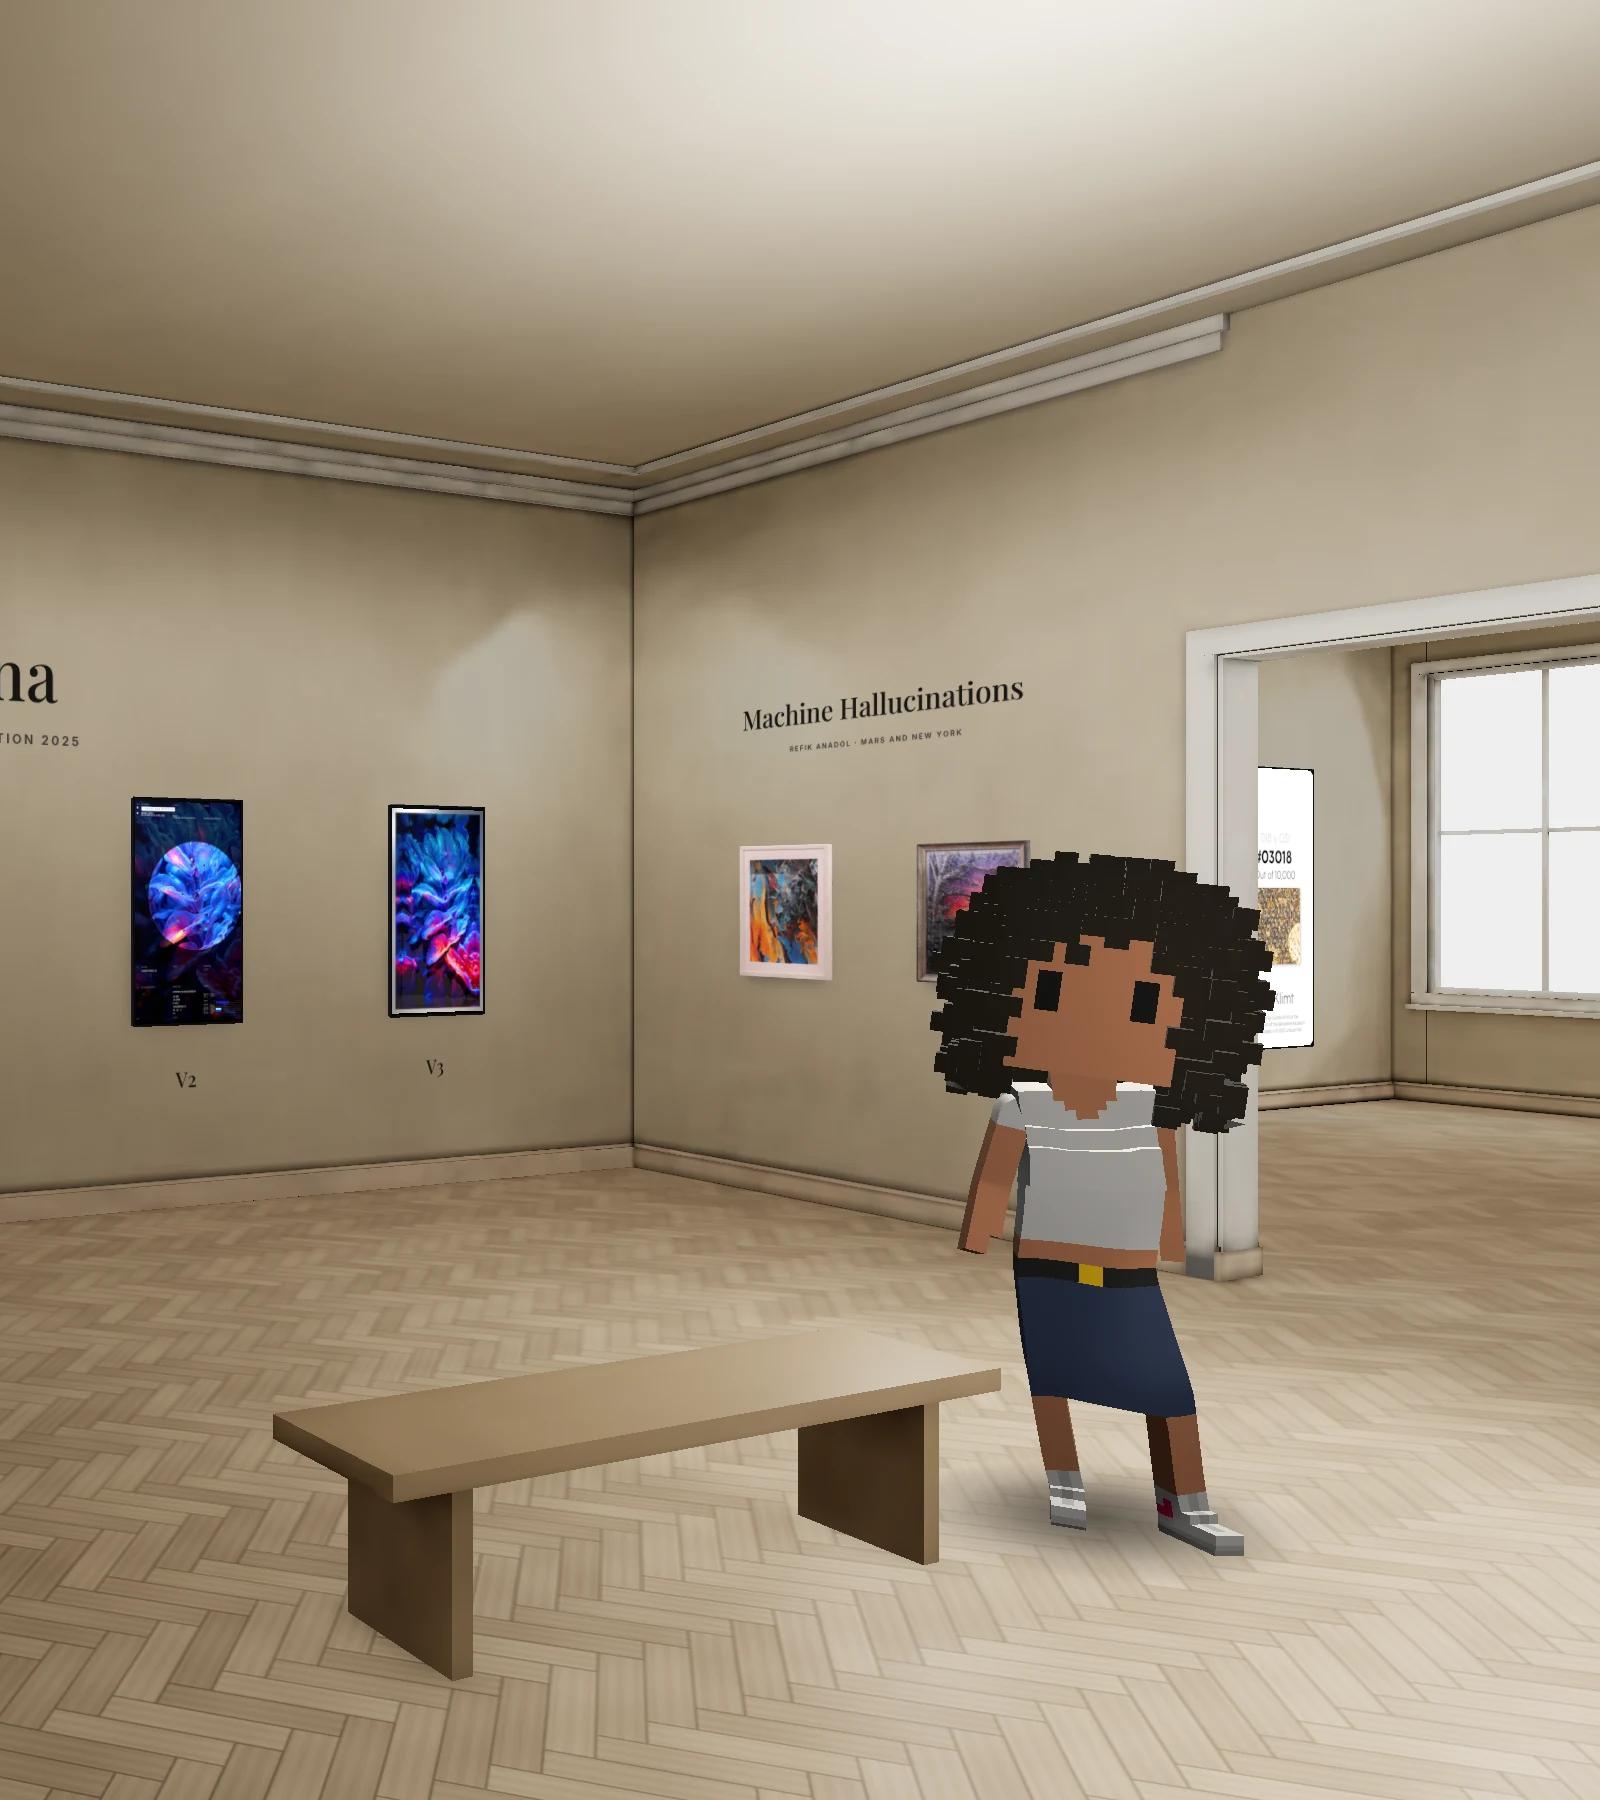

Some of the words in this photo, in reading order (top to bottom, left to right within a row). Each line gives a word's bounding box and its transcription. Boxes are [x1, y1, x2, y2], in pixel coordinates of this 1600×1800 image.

[743, 702, 834, 732] Machine
[840, 680, 1024, 721] Hallucinations
[41, 735, 80, 749] 2025
[789, 743, 813, 753] REFIK
[816, 740, 851, 750] ANADOL
[860, 736, 886, 746] MARS
[889, 733, 908, 743] AND
[912, 731, 933, 741] NEW
[936, 728, 963, 738] YORK
[426, 1058, 444, 1078] V3
[176, 1071, 197, 1088] V2
